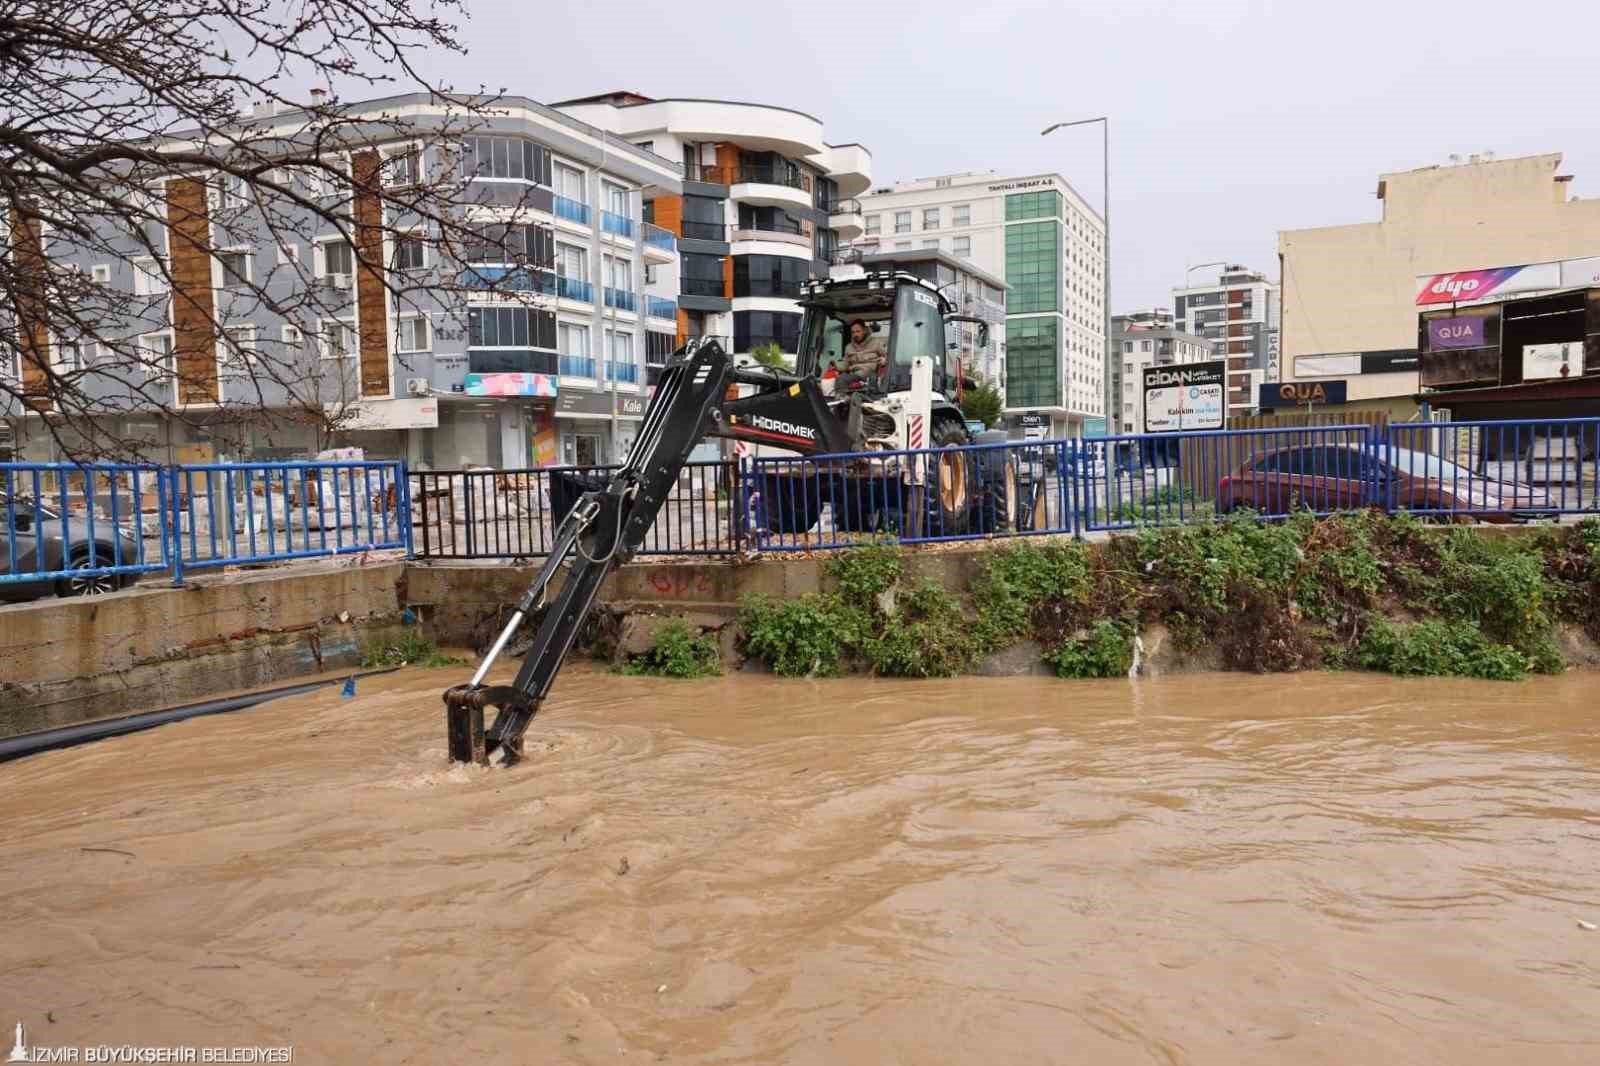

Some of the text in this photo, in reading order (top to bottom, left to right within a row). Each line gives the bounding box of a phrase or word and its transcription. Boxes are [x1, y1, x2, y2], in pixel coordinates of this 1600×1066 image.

[1431, 277, 1479, 298] dyo
[1438, 325, 1473, 338] QUA
[1280, 383, 1327, 400] QUA
[623, 399, 642, 413] Kale
